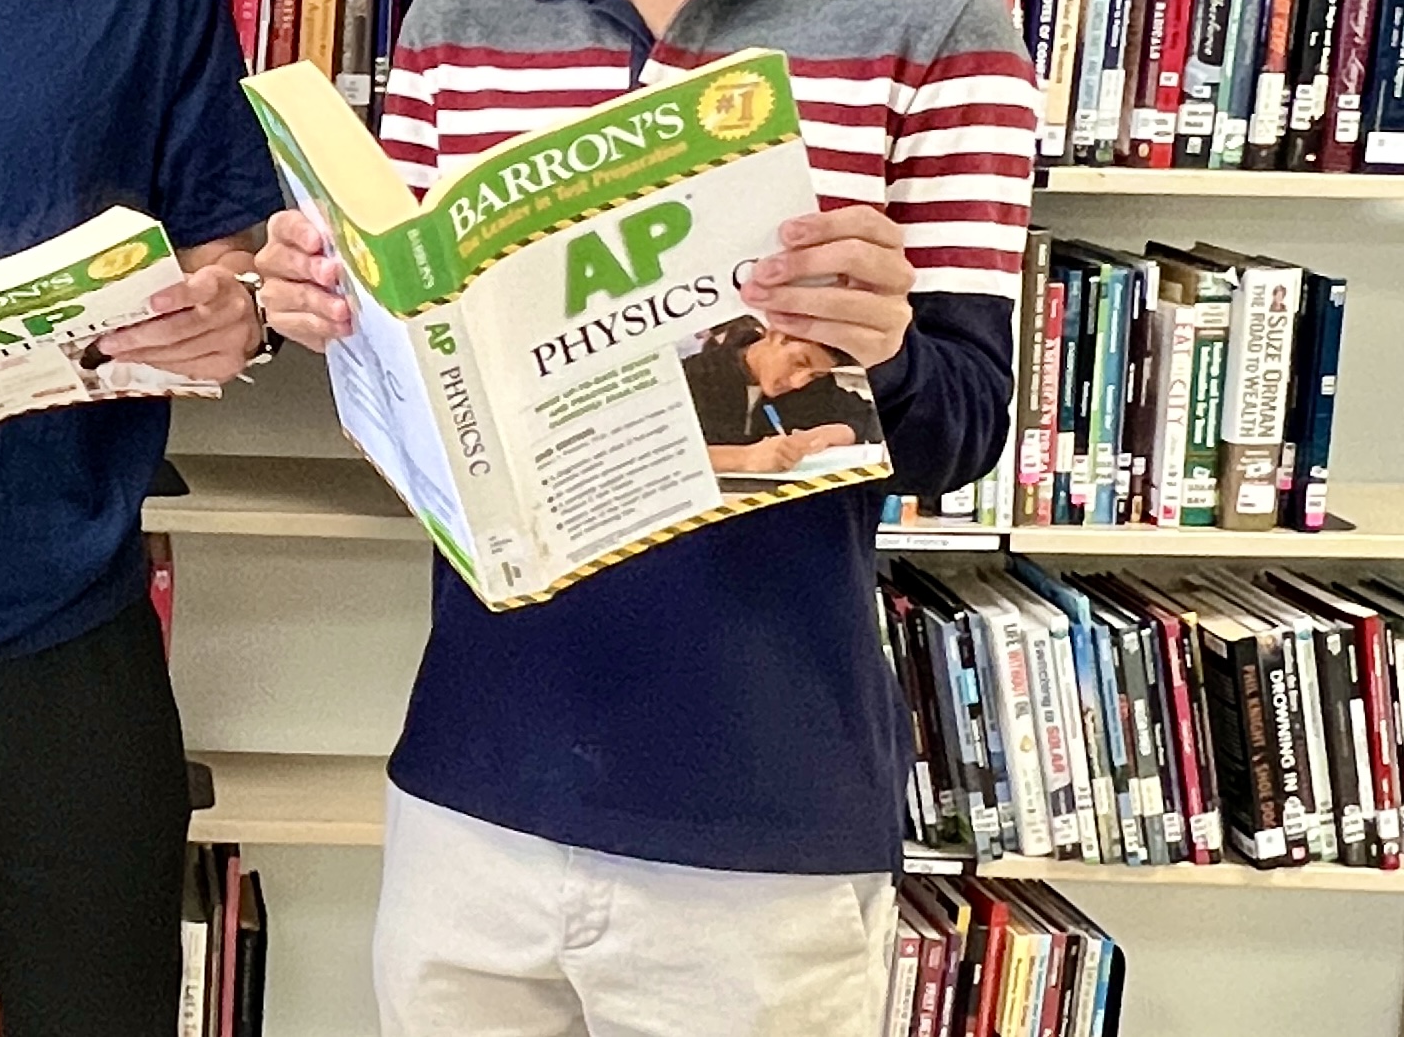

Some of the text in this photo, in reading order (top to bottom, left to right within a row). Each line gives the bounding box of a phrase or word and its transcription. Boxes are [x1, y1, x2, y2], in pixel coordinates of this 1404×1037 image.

[1148, 2, 1165, 60] RADICALS
[716, 89, 754, 122] #1
[447, 101, 684, 243] BARRON'S
[480, 204, 531, 241] Leader
[555, 176, 590, 201] Test
[591, 140, 688, 186] Preparation
[563, 199, 693, 319] AP
[529, 273, 720, 378] PHYSICS
[1167, 323, 1194, 427] EAT CITY
[1238, 284, 1266, 438] THE ROAD TO WEALTH
[423, 322, 492, 478] AP PHYSICS C
[1039, 337, 1059, 426] AMERICAN
[1258, 315, 1288, 438] SUZE ORMAN
[1002, 622, 1022, 648] LIFE
[1005, 648, 1029, 698] WITHOUT
[1242, 664, 1261, 695] PHIL
[1033, 638, 1066, 774] Switching to SOLAR
[1246, 697, 1267, 747] KNIGHT
[1269, 668, 1297, 769] DROWNING
[1253, 762, 1273, 799] SHOE
[1282, 772, 1299, 792] IN
